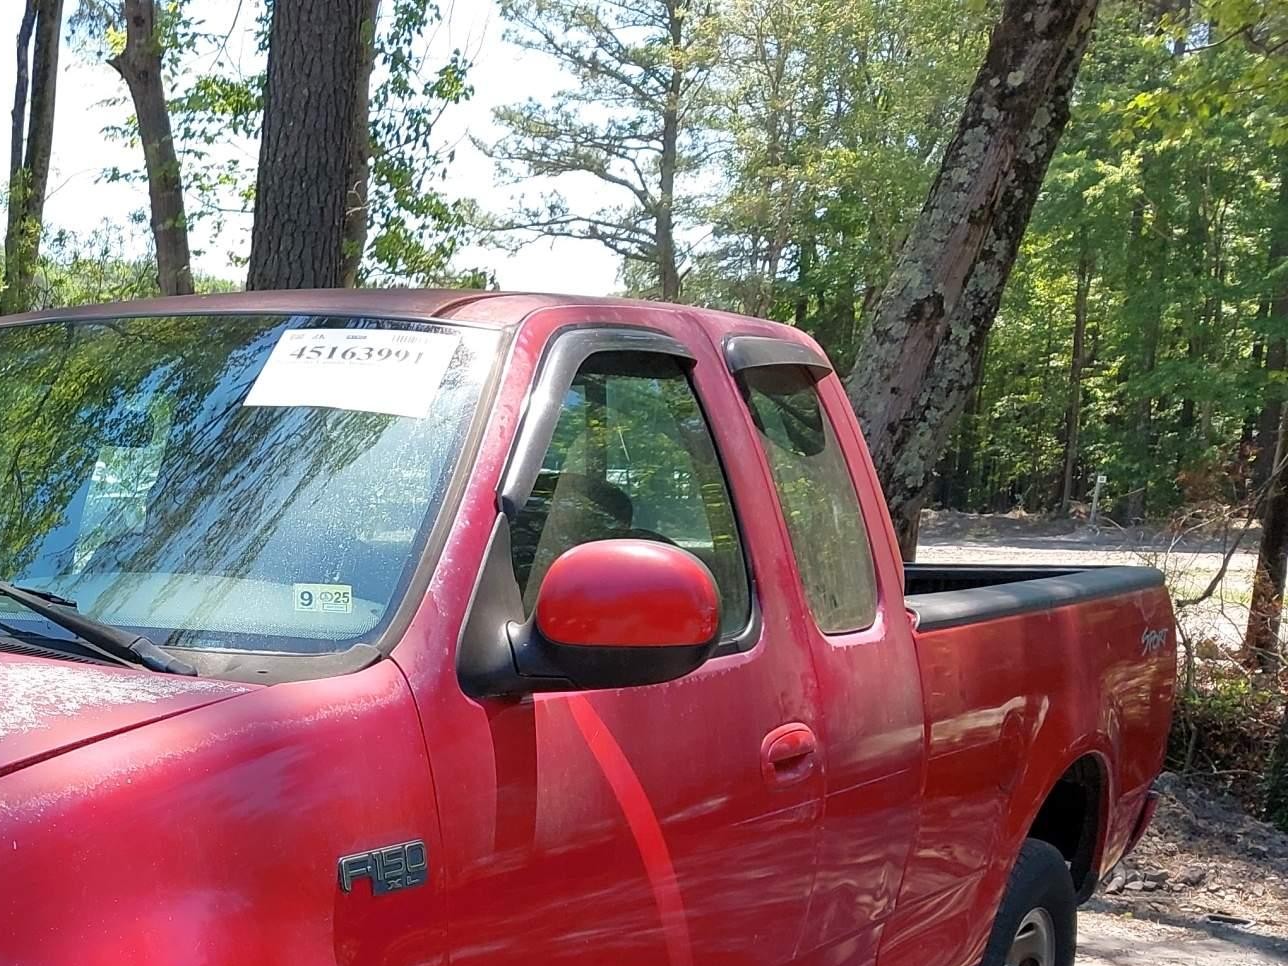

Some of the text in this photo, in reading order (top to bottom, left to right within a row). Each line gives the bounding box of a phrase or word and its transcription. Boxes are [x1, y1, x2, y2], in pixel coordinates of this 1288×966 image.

[289, 345, 424, 365] 45163991
[300, 591, 350, 606] 9 25
